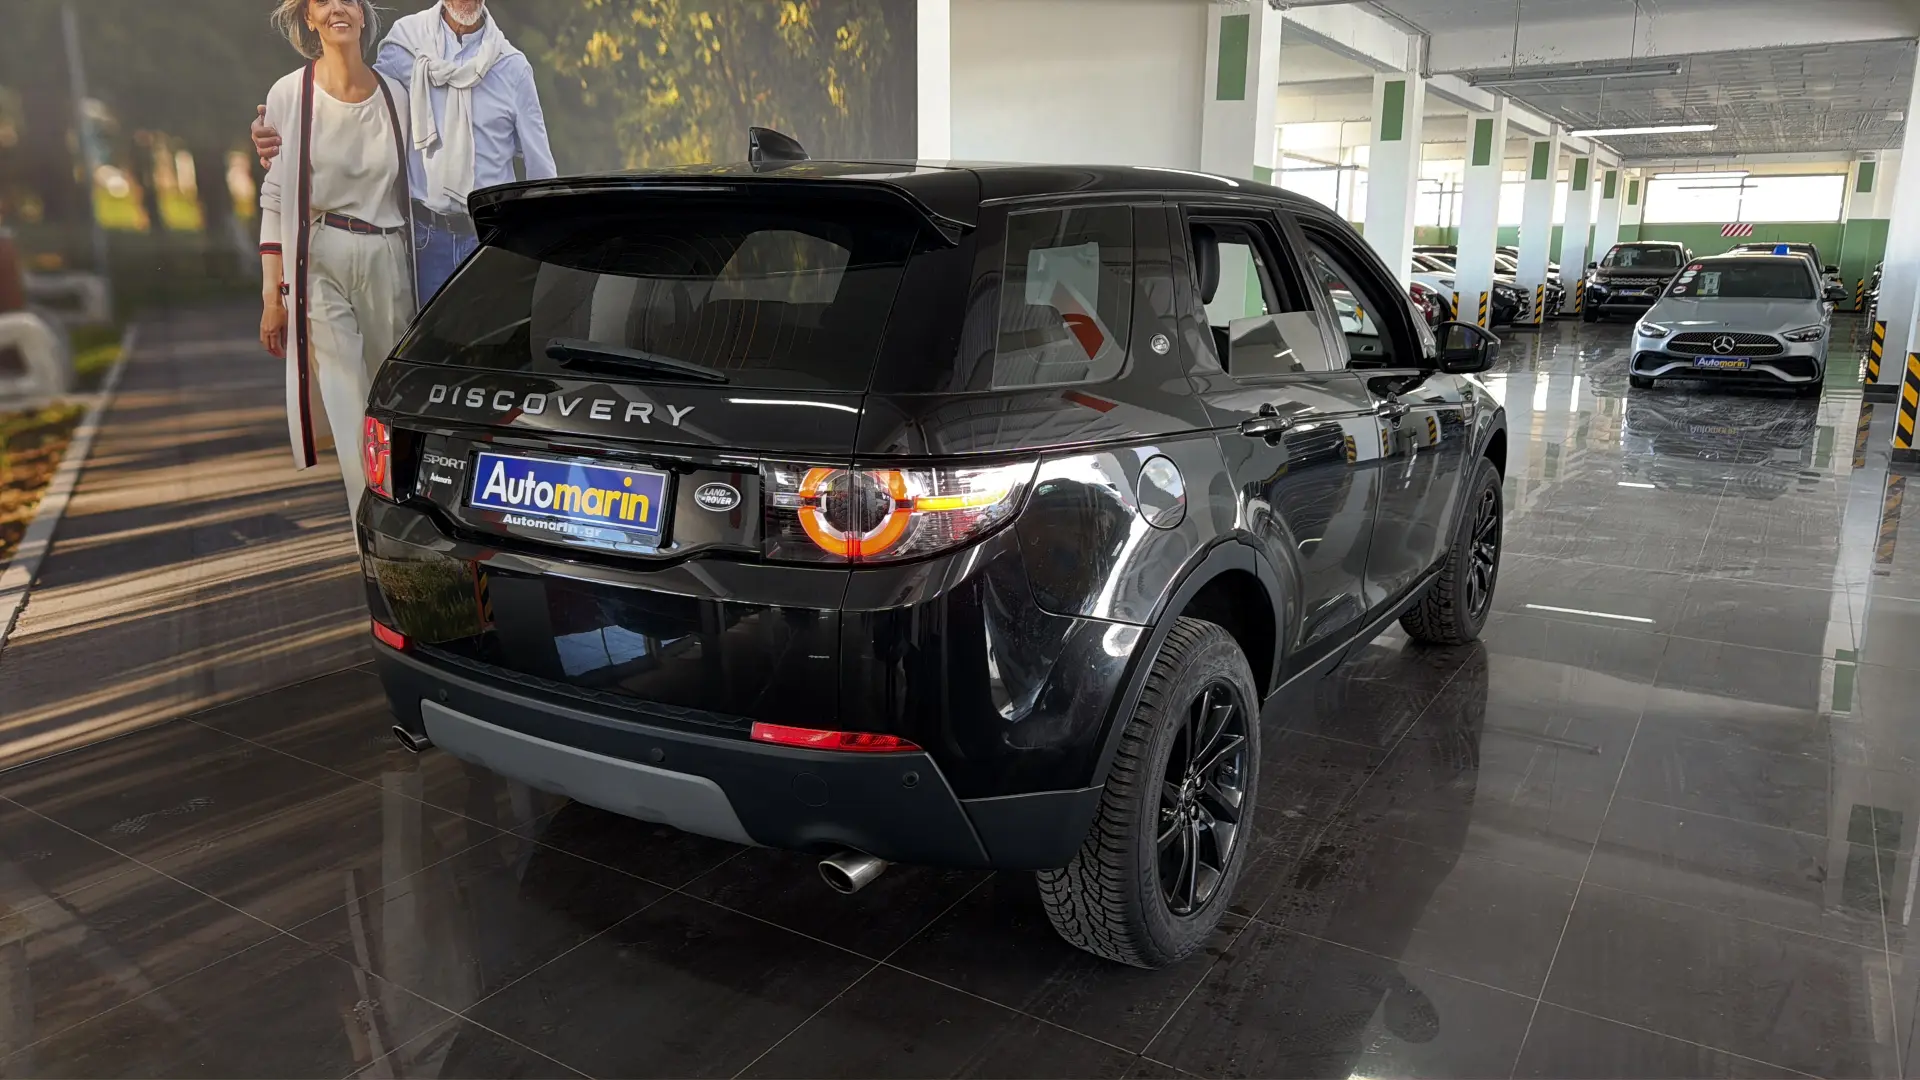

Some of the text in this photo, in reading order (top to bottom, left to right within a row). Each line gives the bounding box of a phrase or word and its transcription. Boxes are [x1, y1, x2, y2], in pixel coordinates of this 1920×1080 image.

[1697, 357, 1746, 368] Automarin
[428, 384, 696, 427] DISCOVERY
[423, 453, 467, 470] SPORT
[482, 460, 650, 523] Automarin
[704, 488, 726, 497] LAND
[705, 496, 732, 505] ROVER
[502, 513, 602, 537] Automarin.gr
